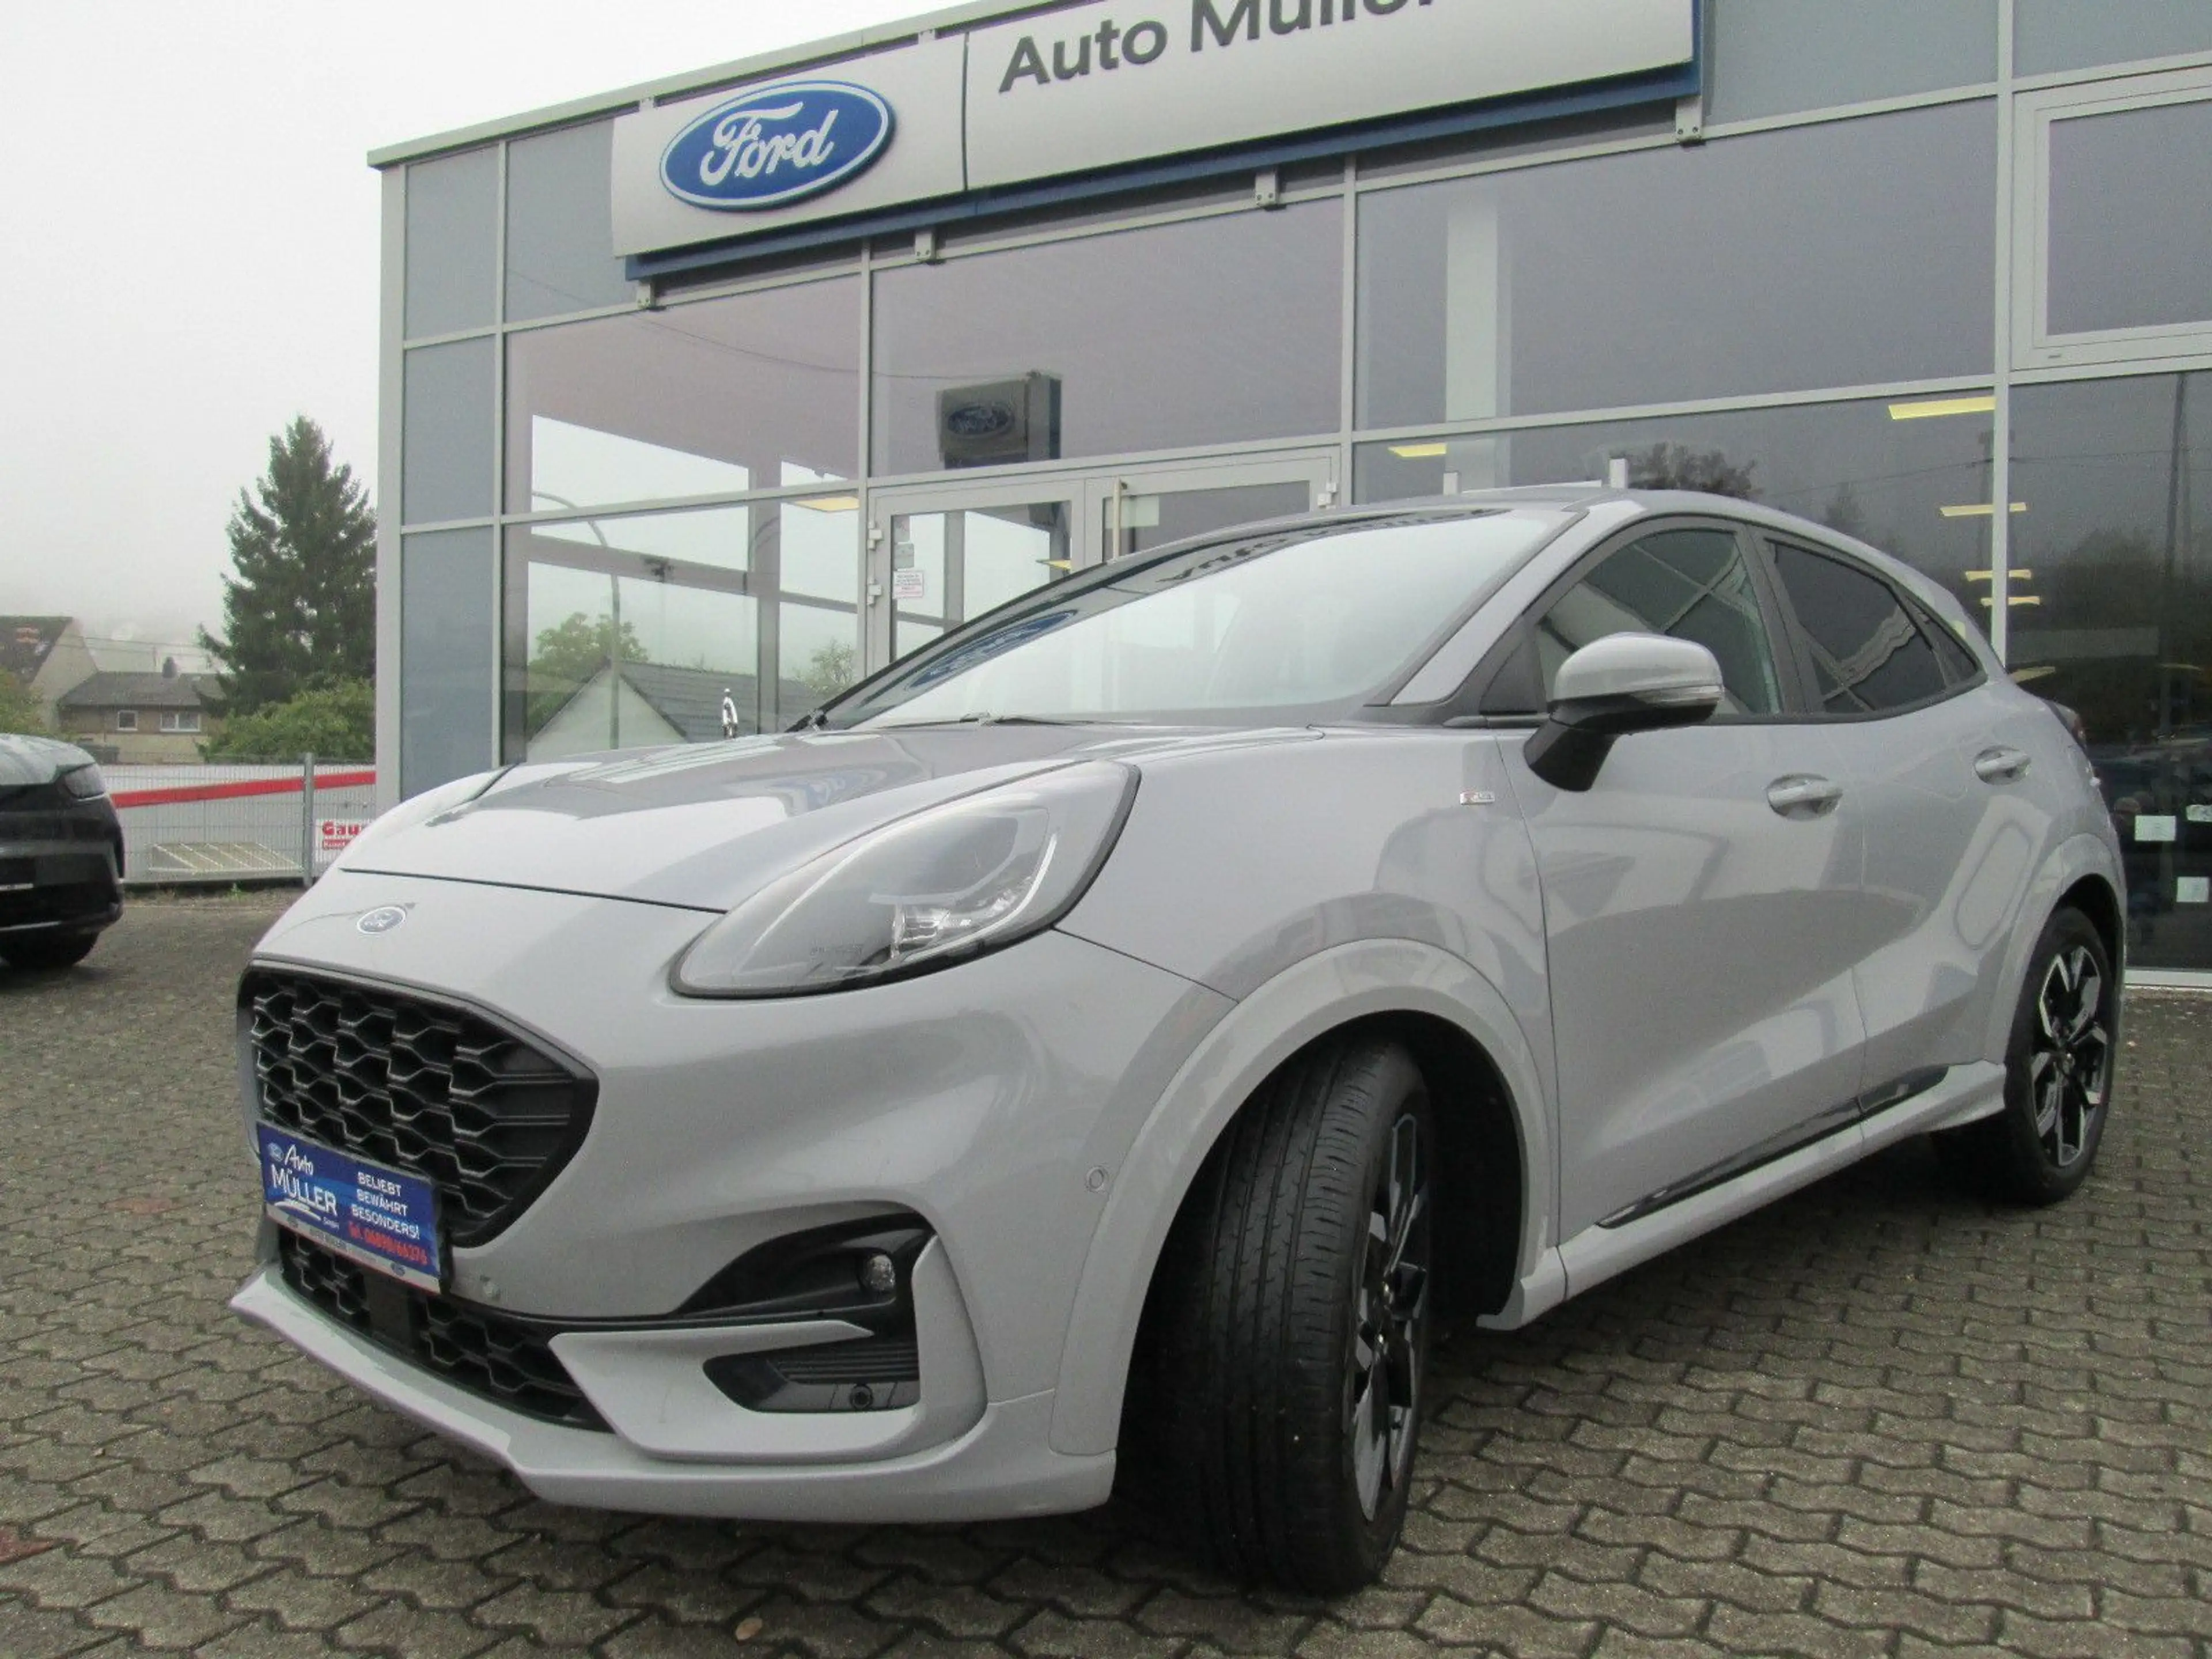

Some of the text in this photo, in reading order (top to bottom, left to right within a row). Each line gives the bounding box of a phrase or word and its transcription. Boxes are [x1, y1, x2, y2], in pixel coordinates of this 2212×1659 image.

[998, 20, 1168, 93] Auto
[699, 101, 839, 186] Ford
[284, 1144, 314, 1176] Auto
[357, 1171, 402, 1197] BELIEBT
[271, 1164, 338, 1217] MÜLLER
